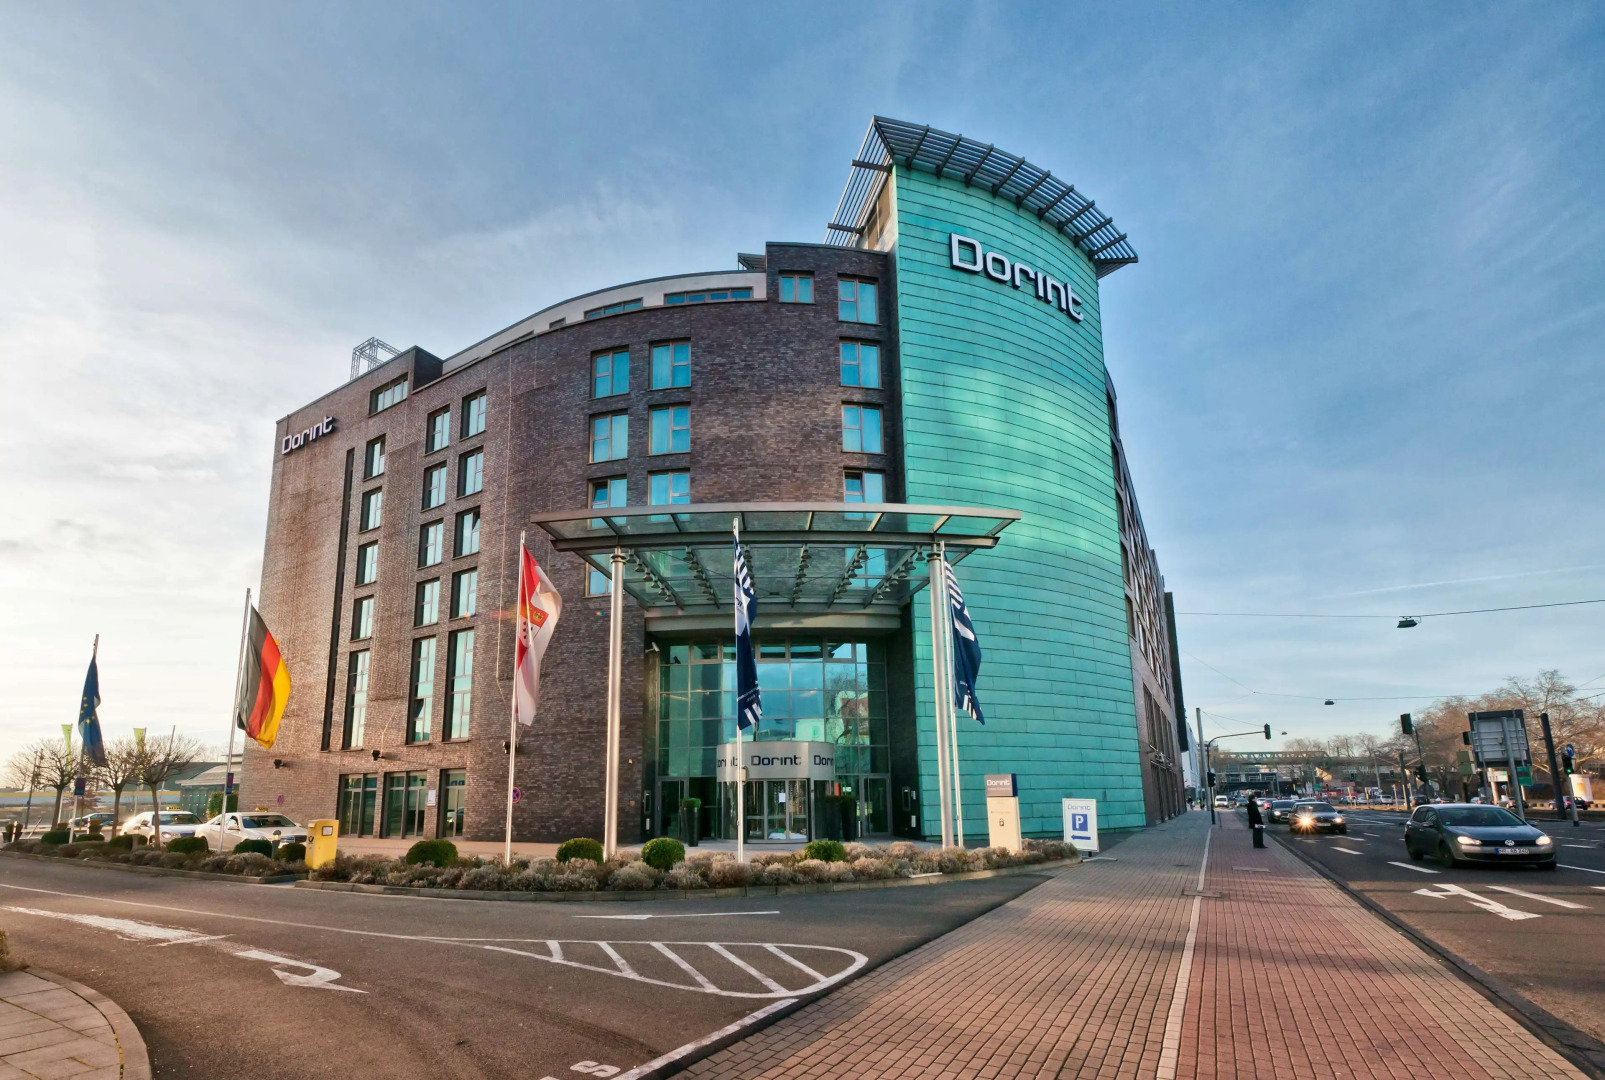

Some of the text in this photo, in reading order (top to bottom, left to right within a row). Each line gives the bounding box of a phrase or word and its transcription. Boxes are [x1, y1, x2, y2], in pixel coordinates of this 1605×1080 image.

[949, 232, 1084, 323] Dorint
[281, 416, 334, 455] Dorint
[751, 755, 802, 766] Dorint
[1075, 815, 1084, 829] P
